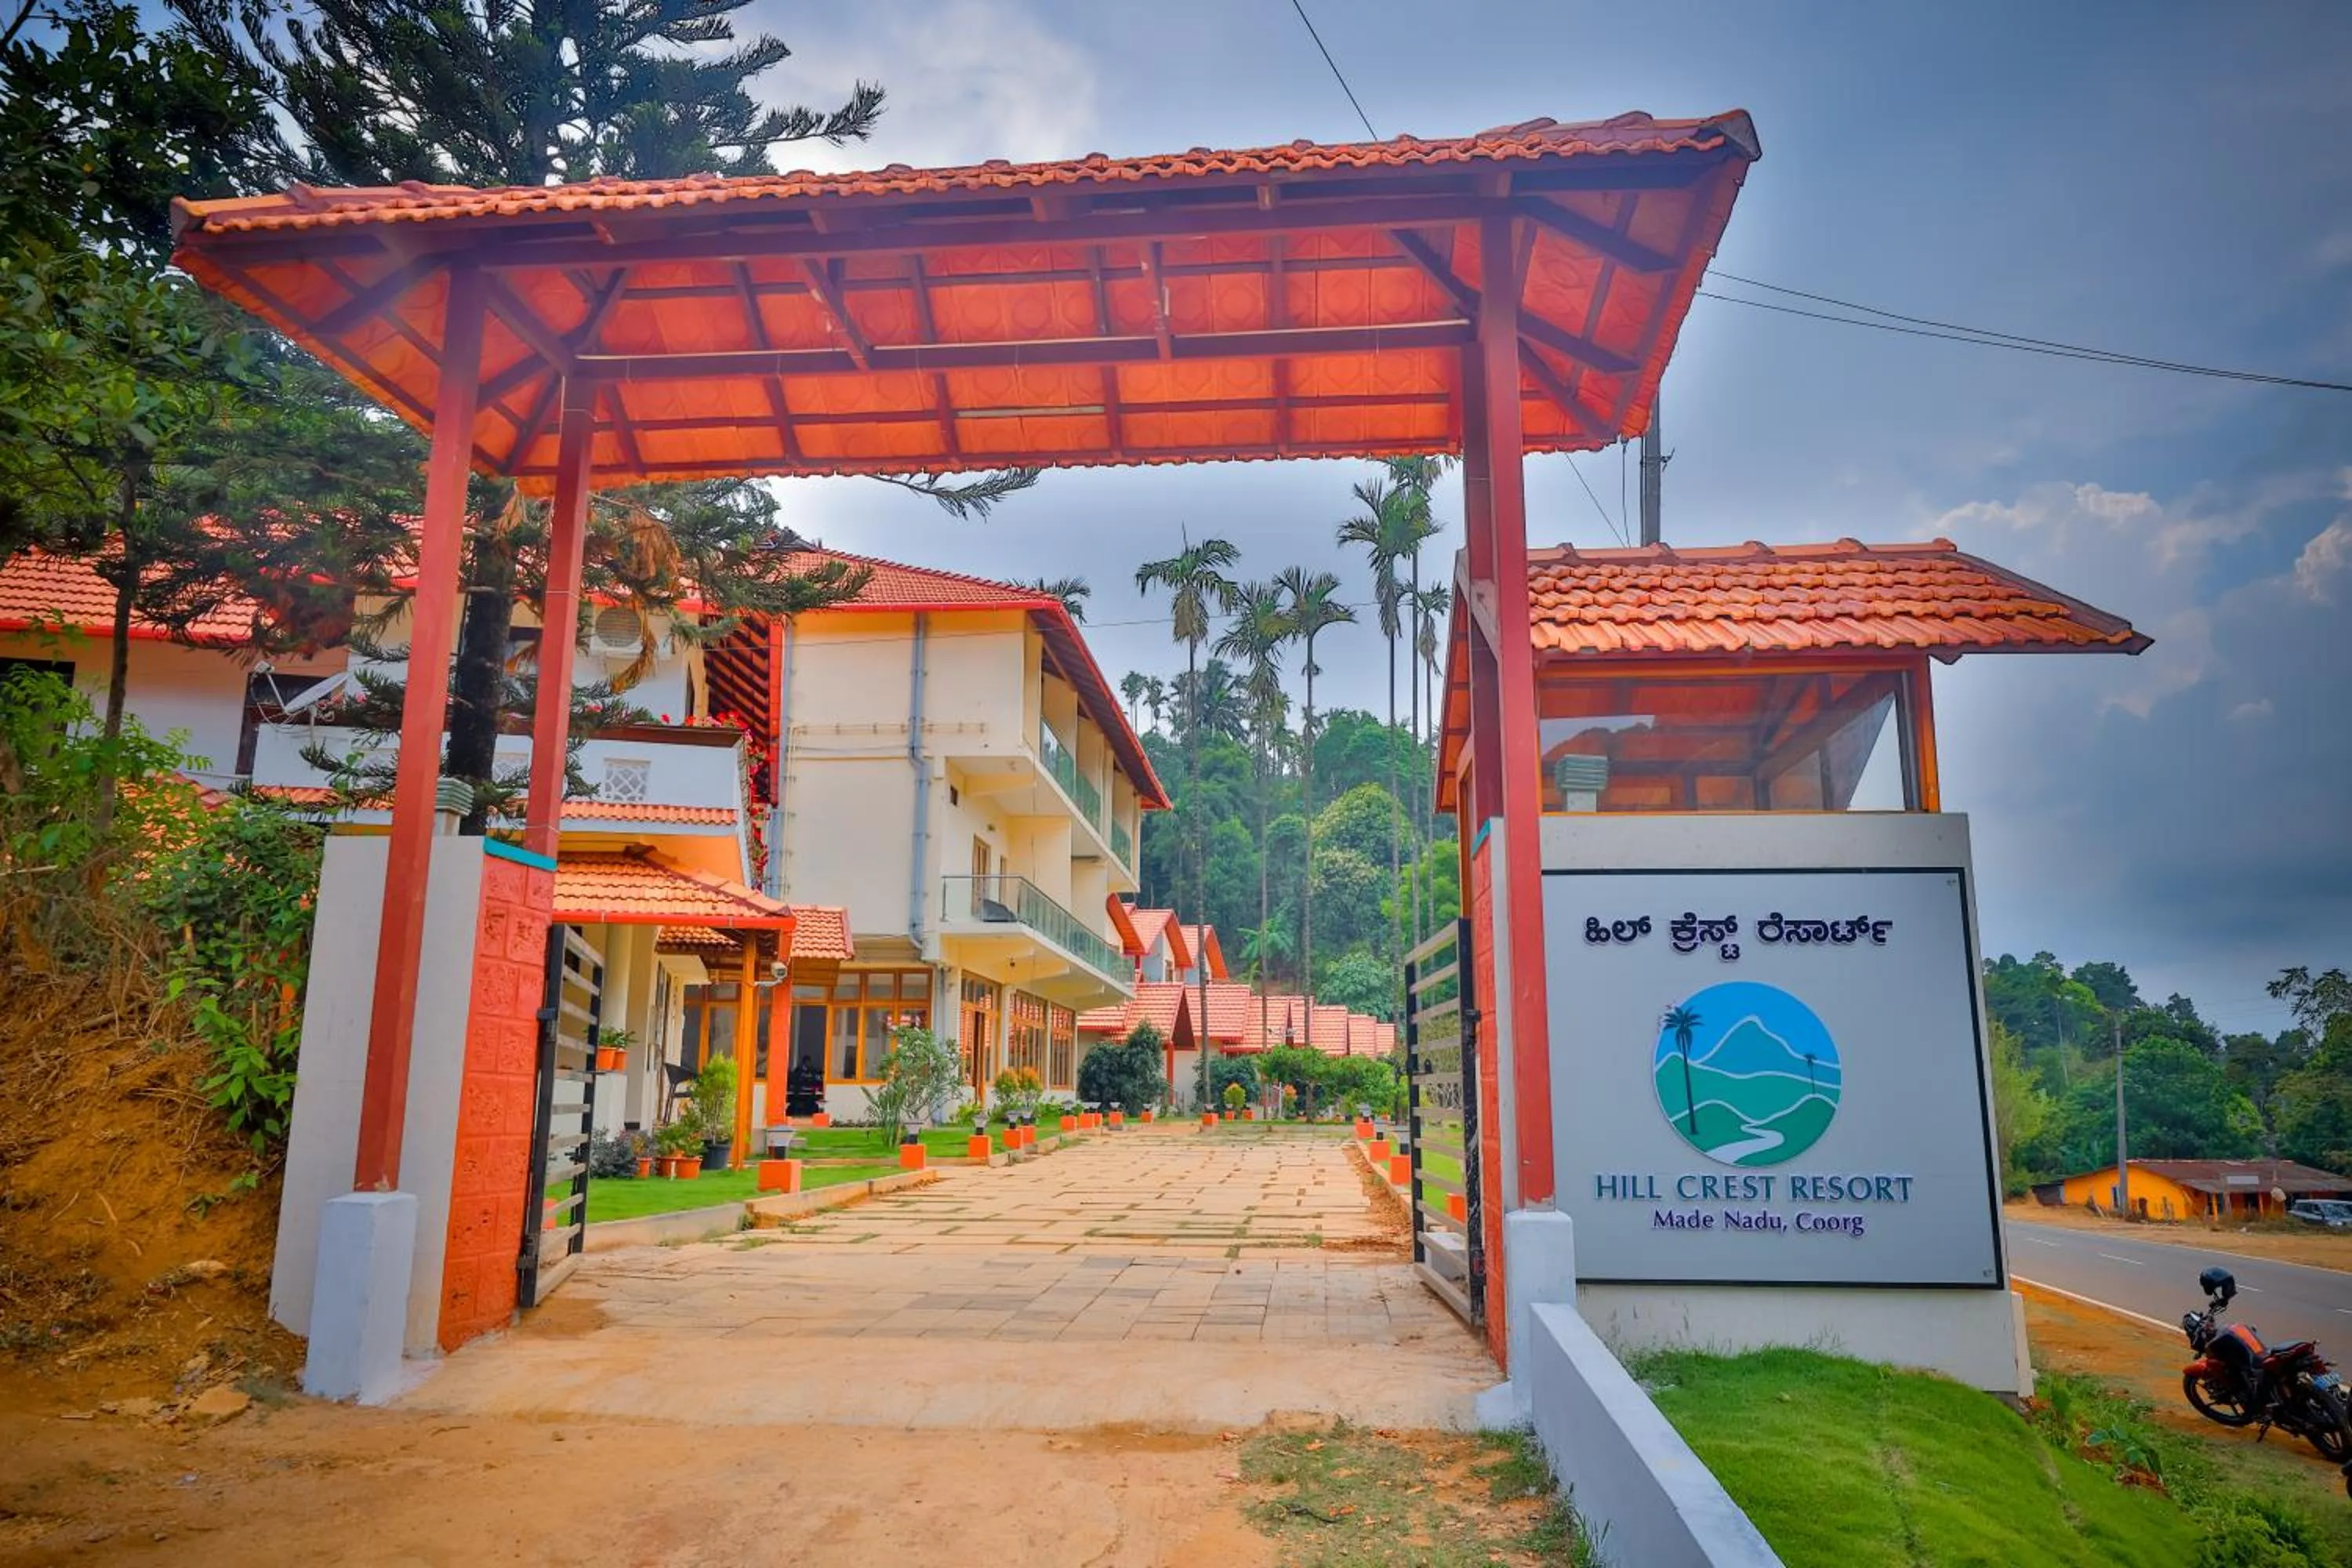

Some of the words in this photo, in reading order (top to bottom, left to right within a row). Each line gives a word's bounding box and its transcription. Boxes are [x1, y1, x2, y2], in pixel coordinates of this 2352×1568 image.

[1584, 915, 1651, 944] ಹಿಲ್
[1670, 912, 1740, 961] ಕ್ರೆಸ್ಟ್
[1757, 912, 1893, 944] ರೆಸಾರ್ಟ್
[1596, 1175, 1663, 1201] HILL
[1676, 1175, 1777, 1202] CREST
[1790, 1175, 1914, 1203] RESORT
[1653, 1209, 1715, 1230] Made
[1724, 1210, 1788, 1233] Nadu,
[1793, 1213, 1864, 1238] Coorg
